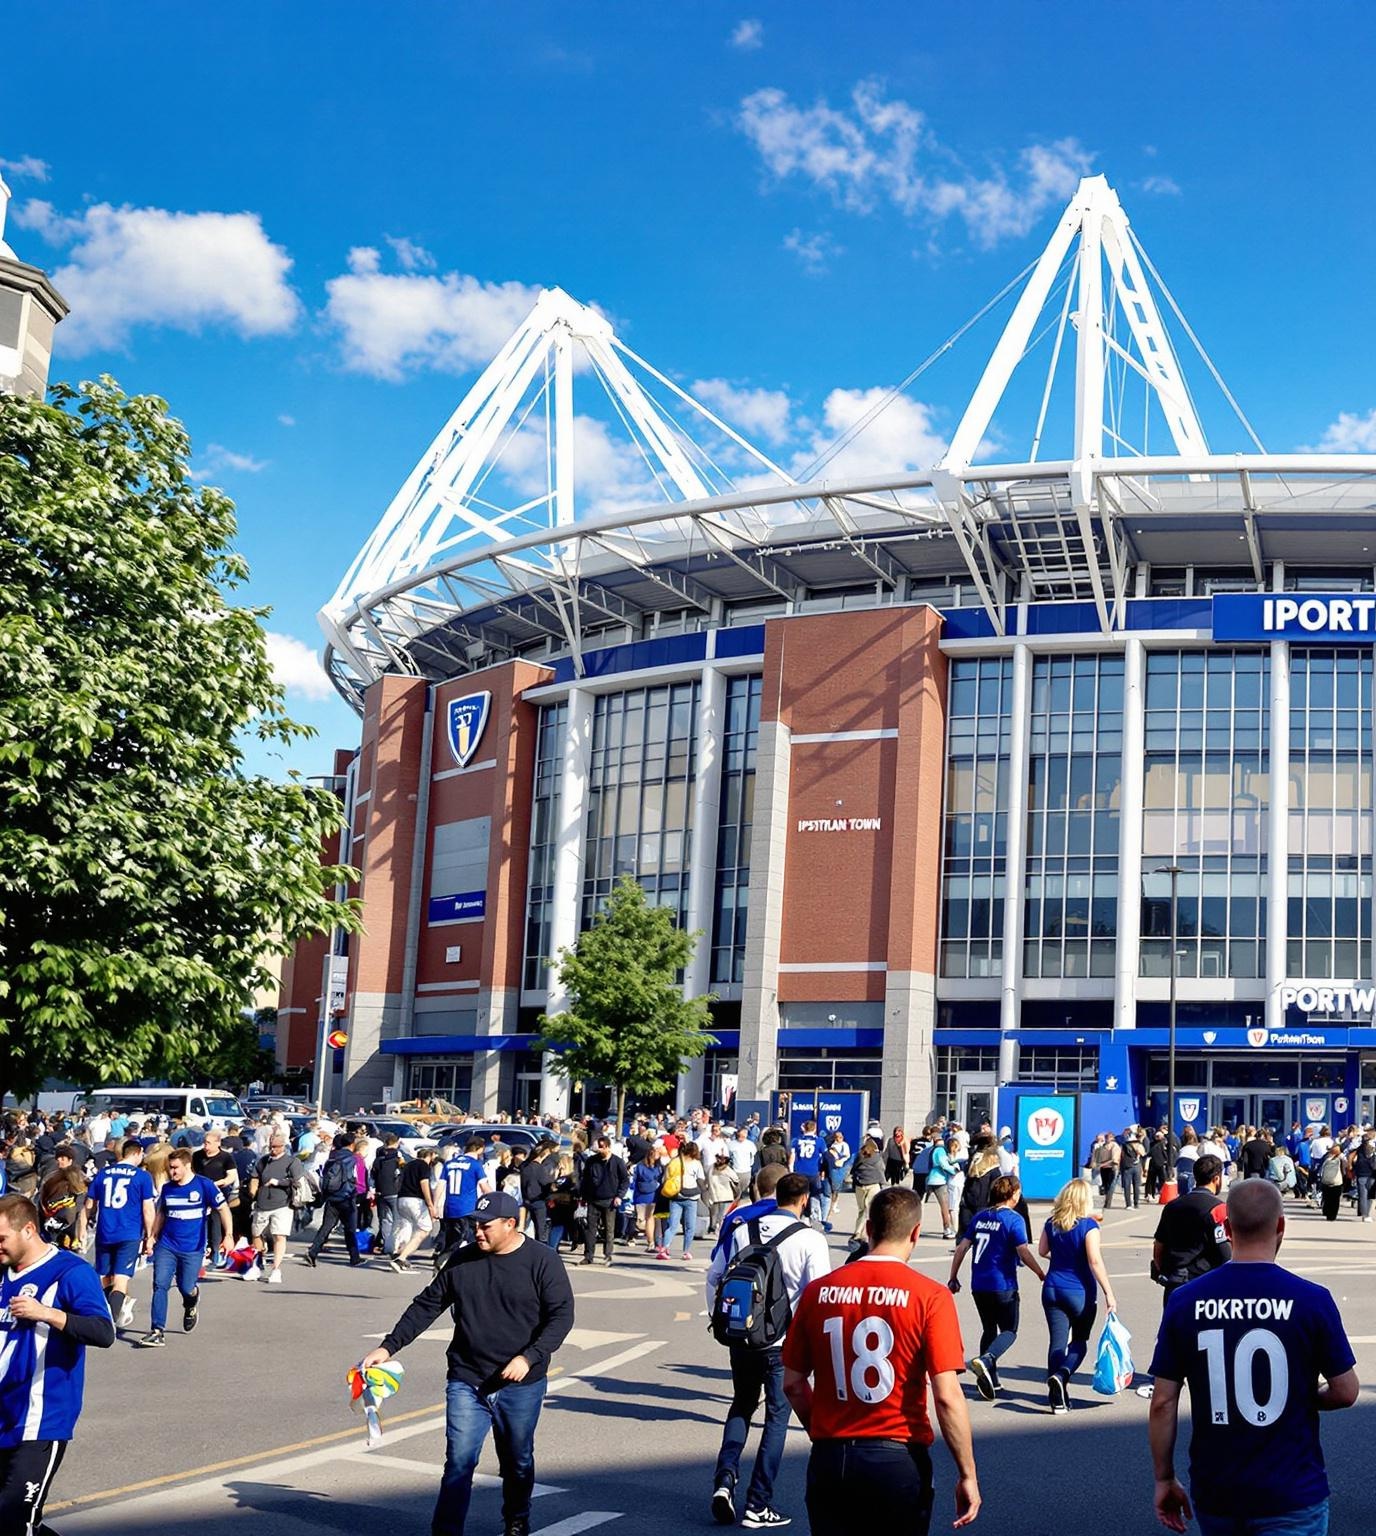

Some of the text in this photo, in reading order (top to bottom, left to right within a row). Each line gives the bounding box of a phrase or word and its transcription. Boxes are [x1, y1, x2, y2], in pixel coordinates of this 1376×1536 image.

[103, 1177, 131, 1209] 16
[448, 1169, 462, 1195] 11
[823, 1315, 895, 1404] 18
[1198, 1327, 1289, 1427] 10
